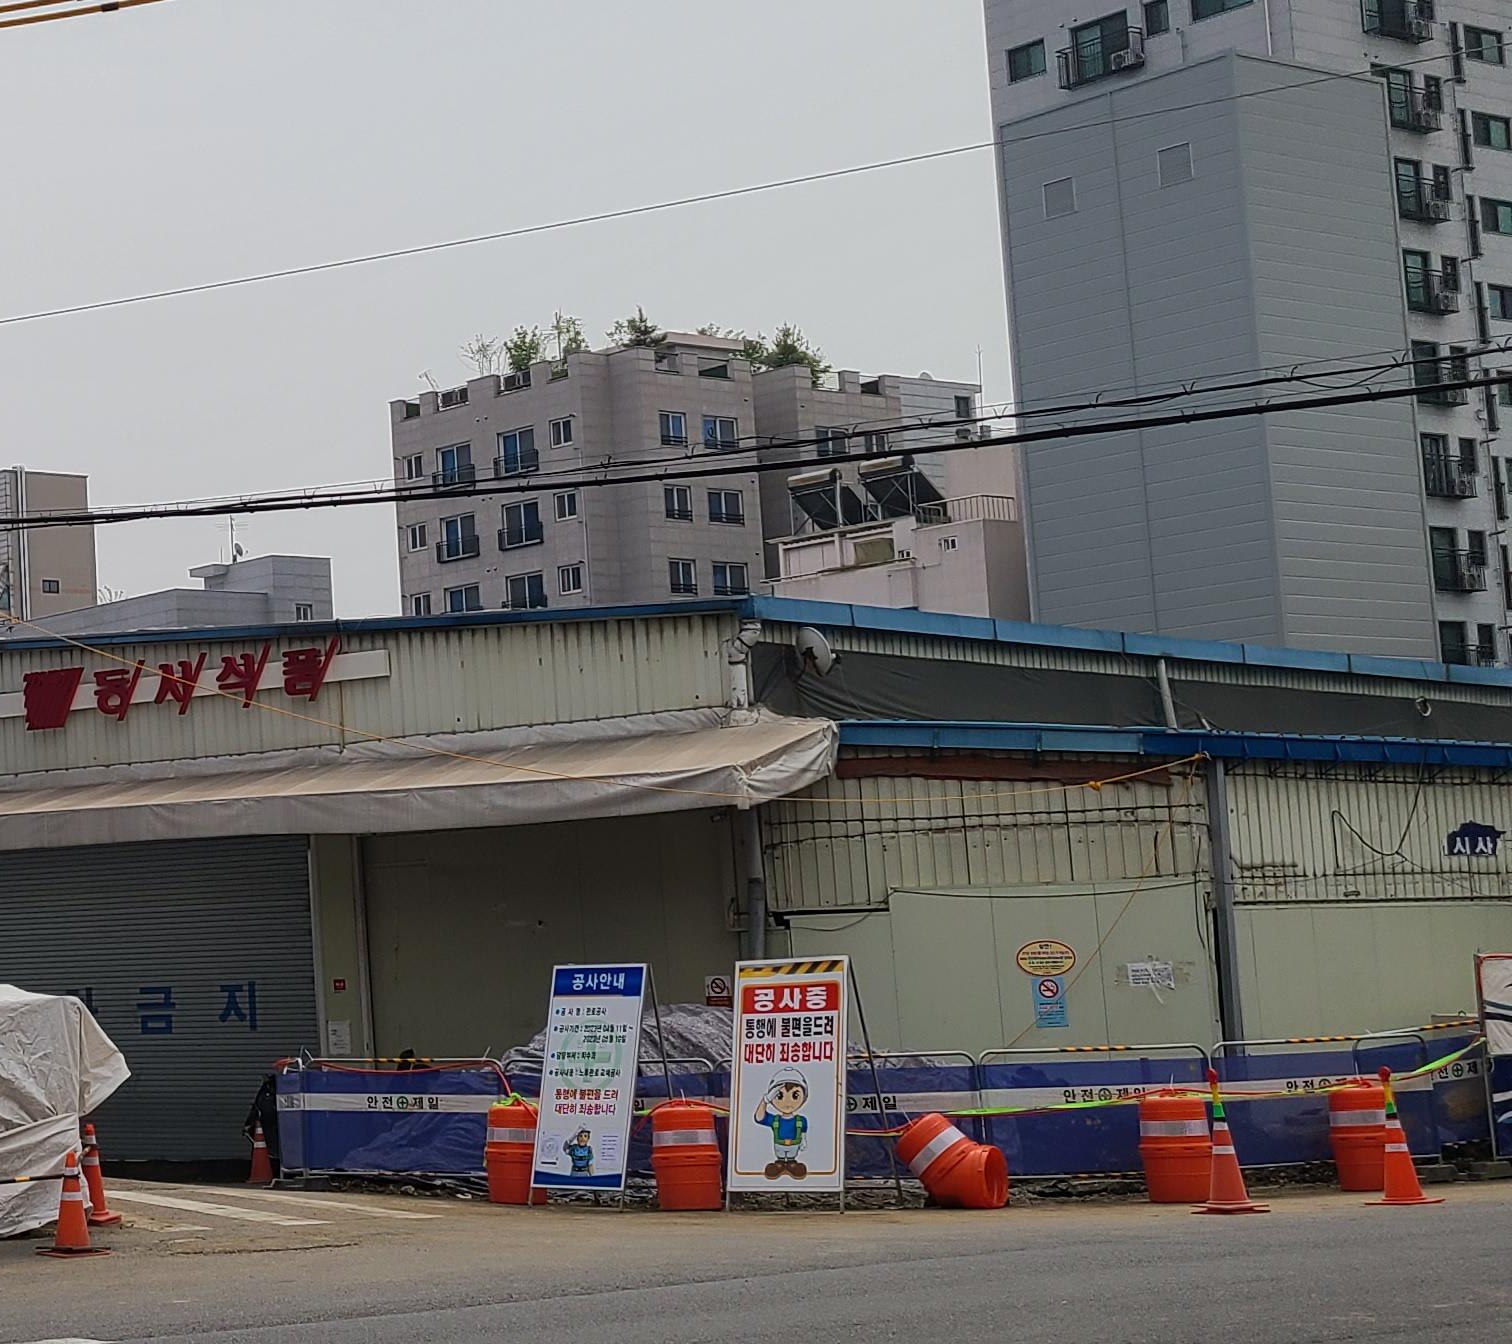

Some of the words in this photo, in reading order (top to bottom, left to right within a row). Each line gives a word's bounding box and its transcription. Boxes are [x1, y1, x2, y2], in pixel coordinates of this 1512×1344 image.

[94, 634, 340, 722] 동서식품
[572, 972, 625, 991] 공사안내
[753, 986, 827, 1012] 공사중
[745, 1018, 777, 1039] 통행에
[744, 1042, 776, 1064] 대단히
[779, 1040, 834, 1062] 죄송합니다
[366, 1096, 393, 1110] 안전
[412, 1096, 439, 1110] 제일
[554, 1088, 578, 1101] 통행에
[862, 1096, 897, 1110] 제일
[554, 1103, 577, 1115] 대단히
[578, 1103, 617, 1116] 죄송합니다
